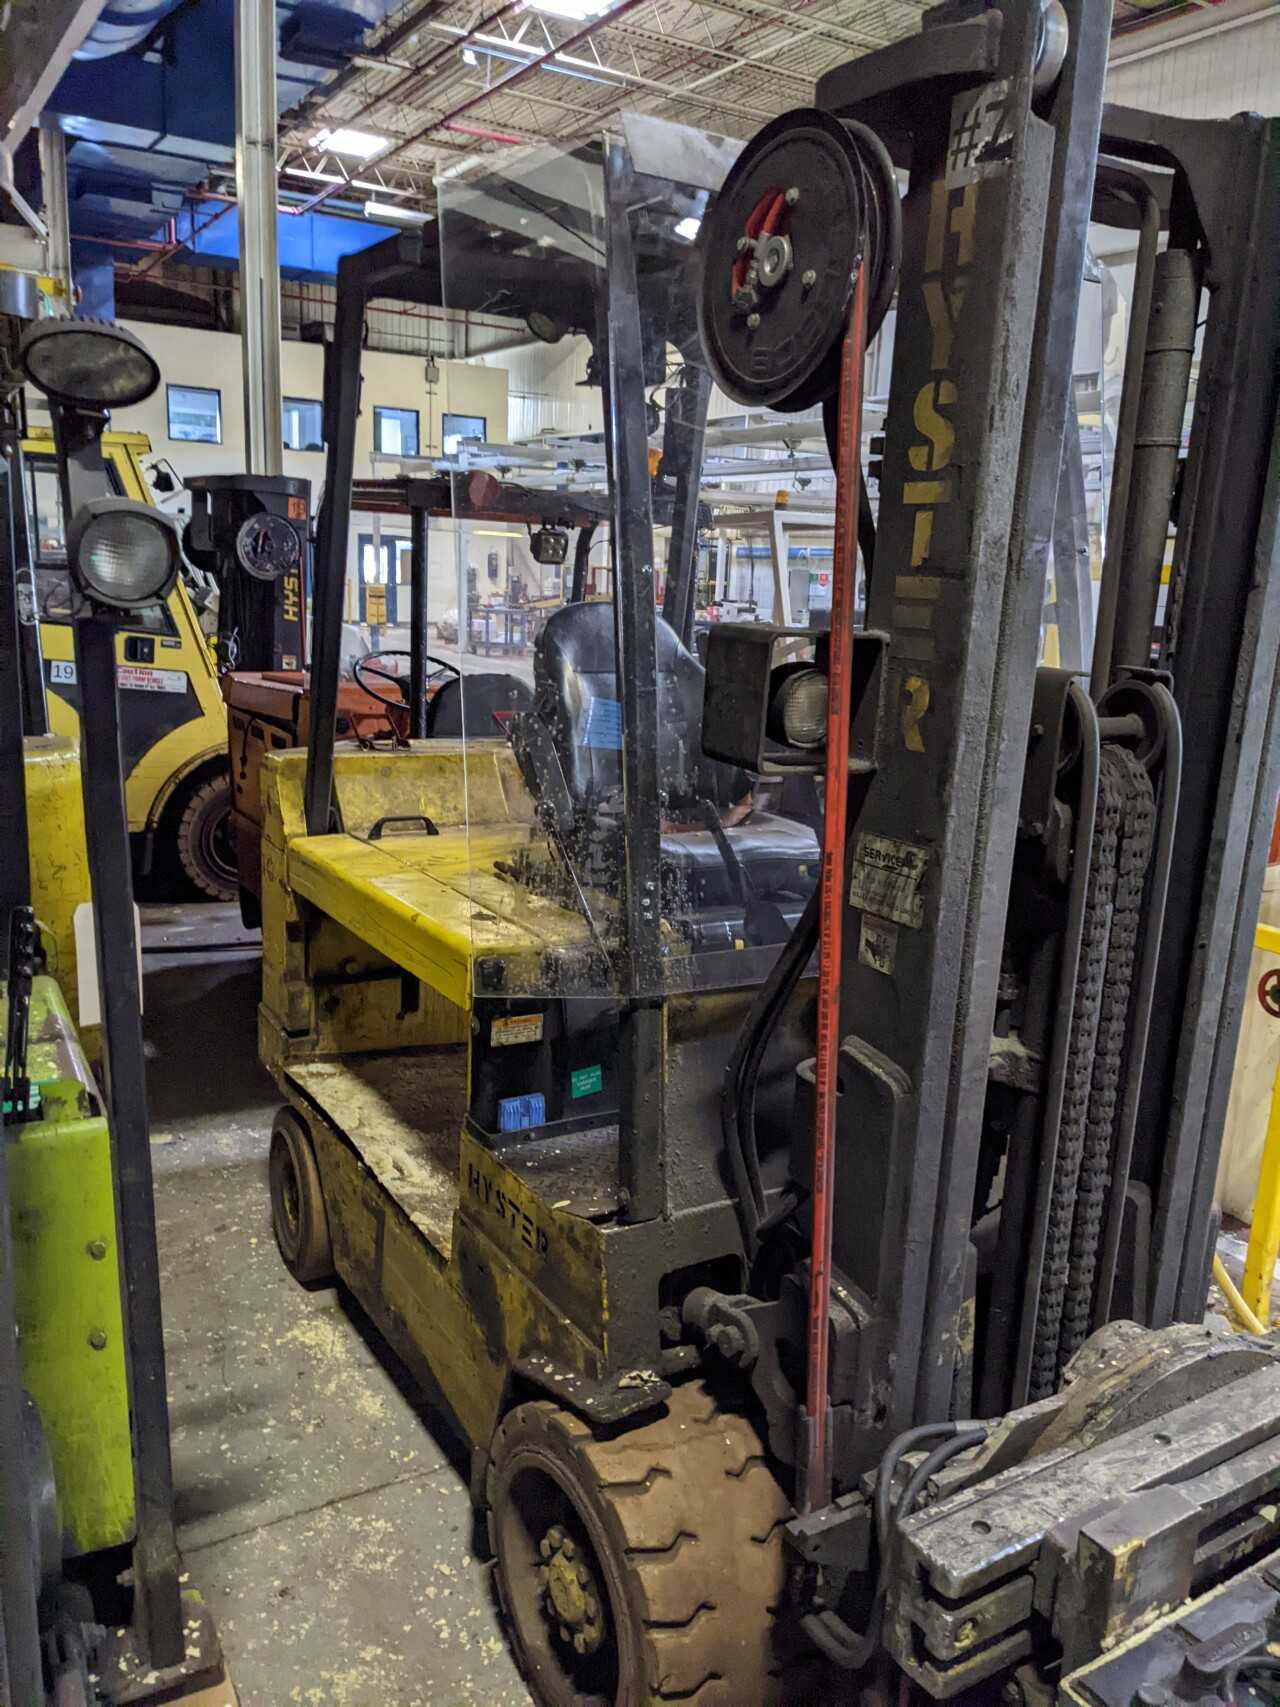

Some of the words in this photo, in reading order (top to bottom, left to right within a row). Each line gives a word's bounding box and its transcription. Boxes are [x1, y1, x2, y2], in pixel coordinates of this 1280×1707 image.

[950, 99, 1010, 171] #7
[893, 178, 977, 752] HYSTER
[52, 664, 74, 679] 19
